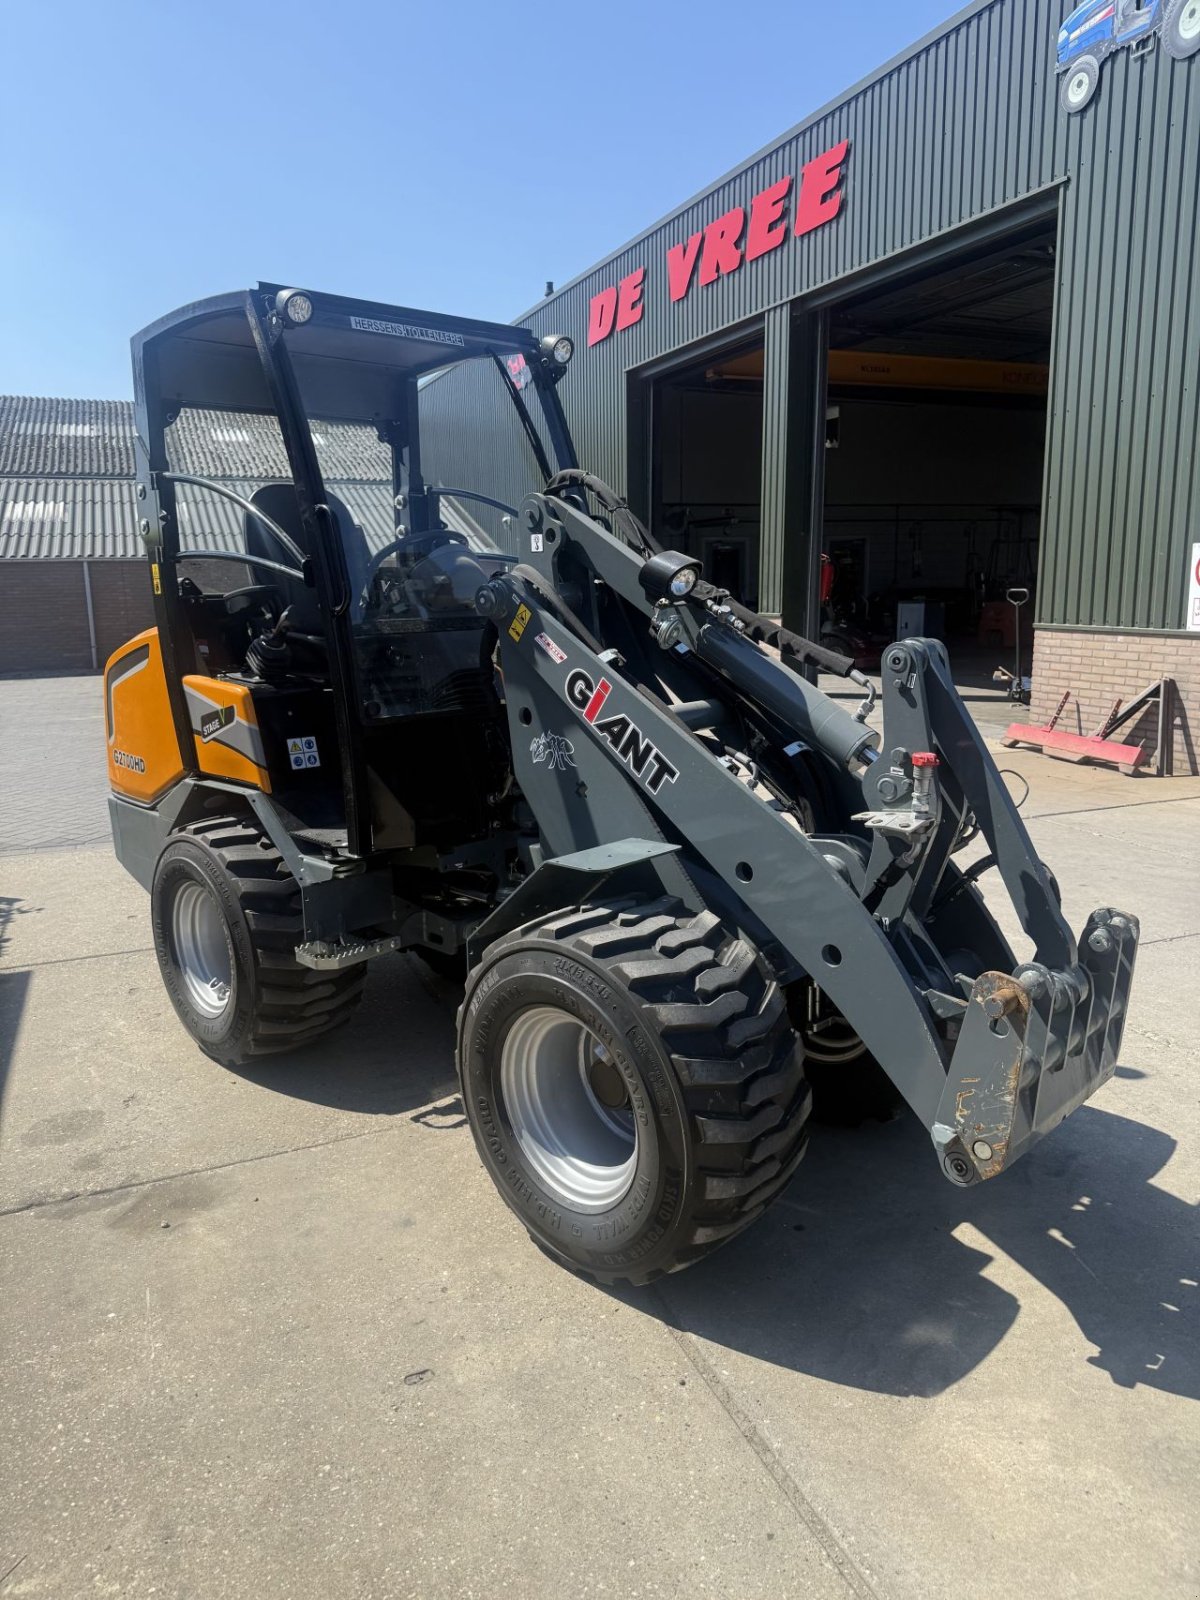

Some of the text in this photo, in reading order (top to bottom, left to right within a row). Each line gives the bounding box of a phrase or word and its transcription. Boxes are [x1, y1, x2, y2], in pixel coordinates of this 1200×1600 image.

[588, 138, 850, 348] DE VREE
[354, 319, 403, 336] HERSSENS
[202, 719, 221, 736] STAGE
[112, 749, 147, 774] G2700HD
